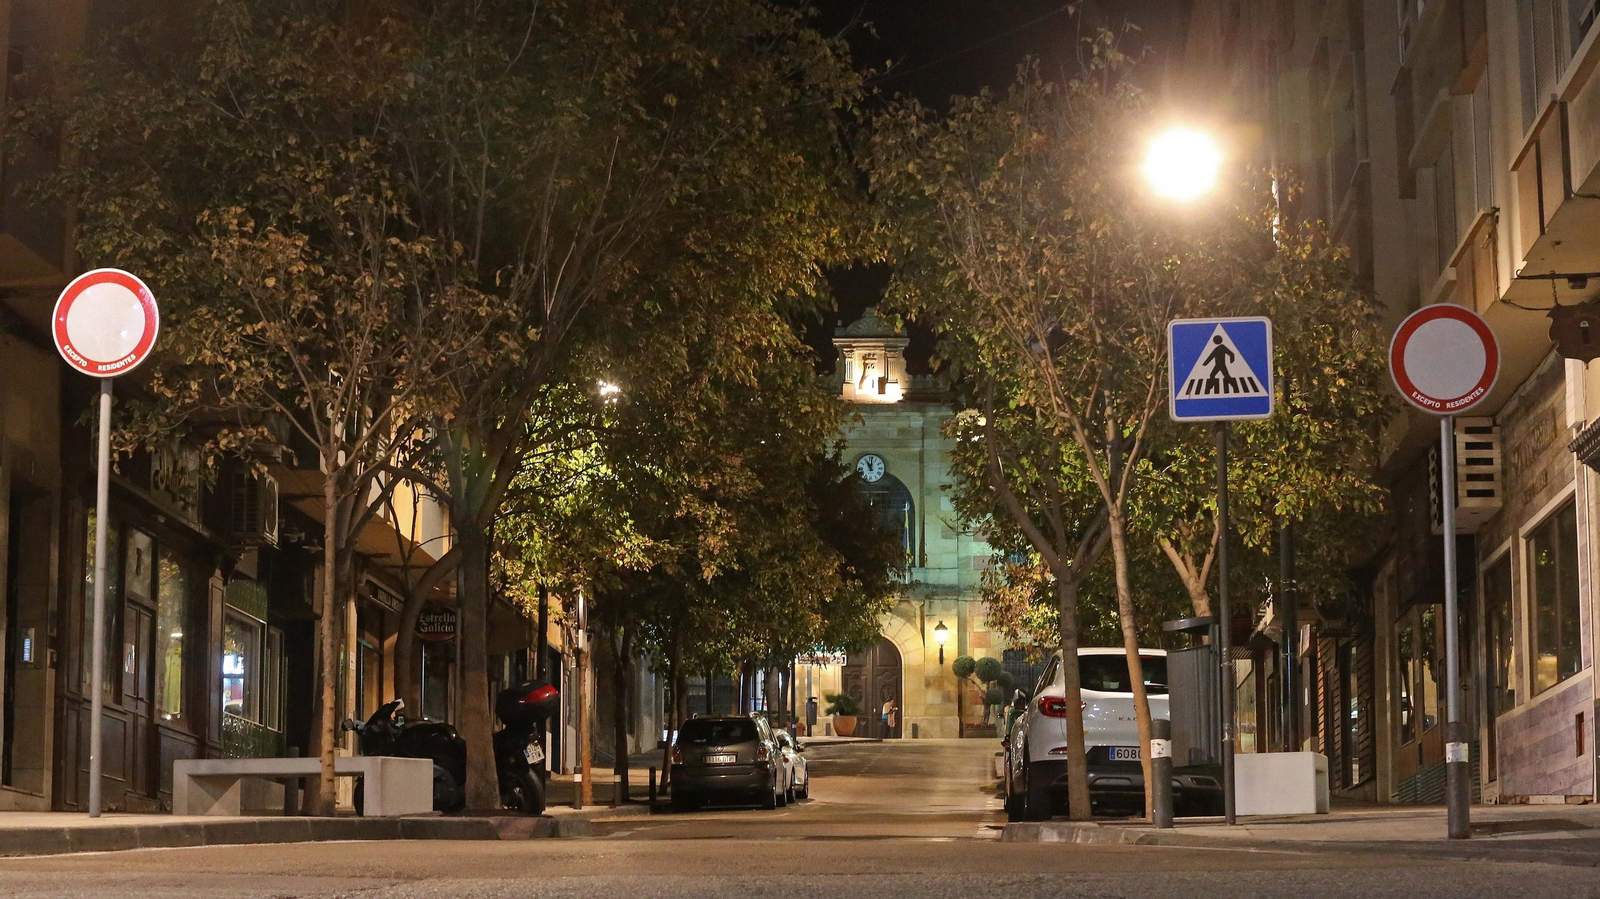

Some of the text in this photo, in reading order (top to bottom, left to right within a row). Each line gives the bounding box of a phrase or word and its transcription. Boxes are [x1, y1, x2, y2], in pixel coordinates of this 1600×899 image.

[63, 344, 136, 371] EXCEPTO RESIDENTES
[1411, 386, 1484, 409] EXCEPTO RESIDENTES
[420, 612, 456, 623] Estrella
[420, 623, 454, 633] Galicia
